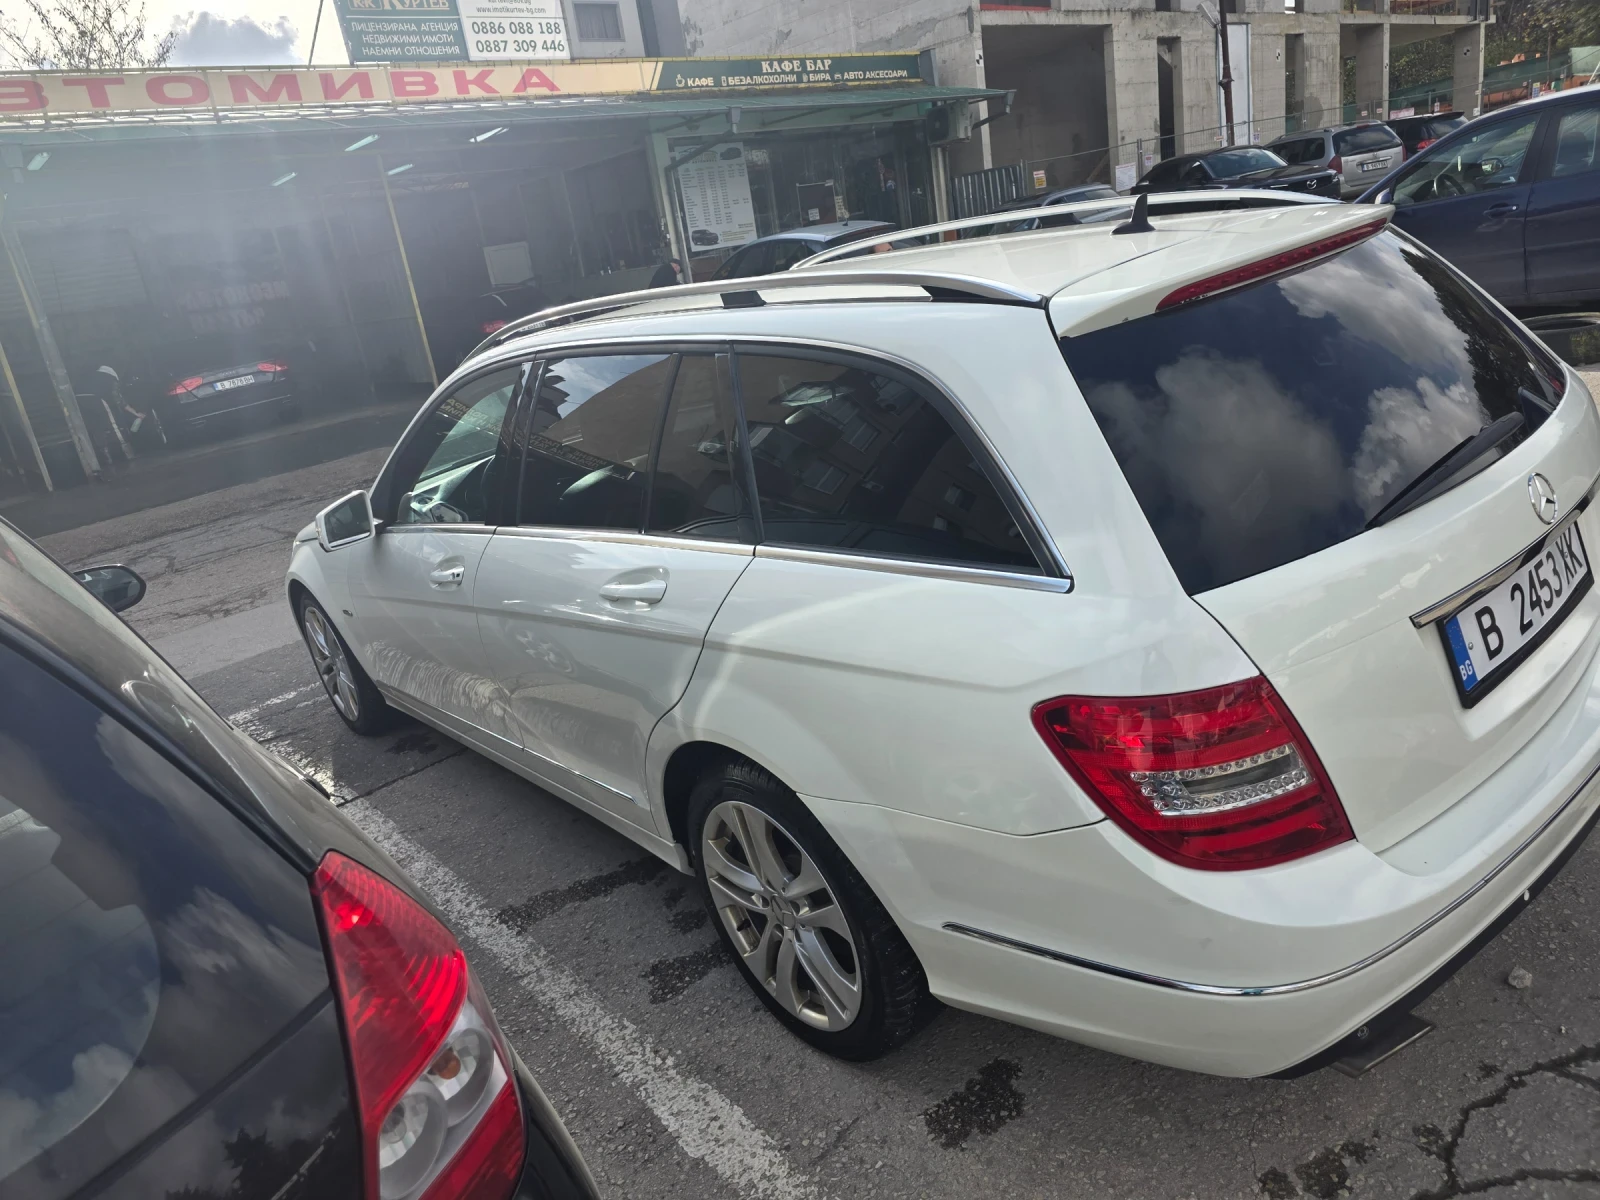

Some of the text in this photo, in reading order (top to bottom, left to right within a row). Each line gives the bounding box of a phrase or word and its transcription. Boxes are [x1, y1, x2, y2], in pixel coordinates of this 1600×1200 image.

[351, 22, 459, 32] ЛИЦЕНЗИРАНА АГЕНЦИЯ
[471, 21, 561, 35] 0886 088 188
[362, 34, 454, 45] НЕДВИЖИМИ ИМОТИ
[475, 39, 565, 53] 0887 309 446
[362, 45, 460, 56] НАЕМНИ ОТНОШЕНИЯ
[761, 59, 832, 73] КАФЕ БАР
[687, 70, 908, 87] КАФЕ БЕЗАЛКОХОЛНИ БИРА АВТО АКСЕСОАРИ
[1475, 526, 1583, 661] B 2453 XK
[1459, 660, 1473, 681] BG
